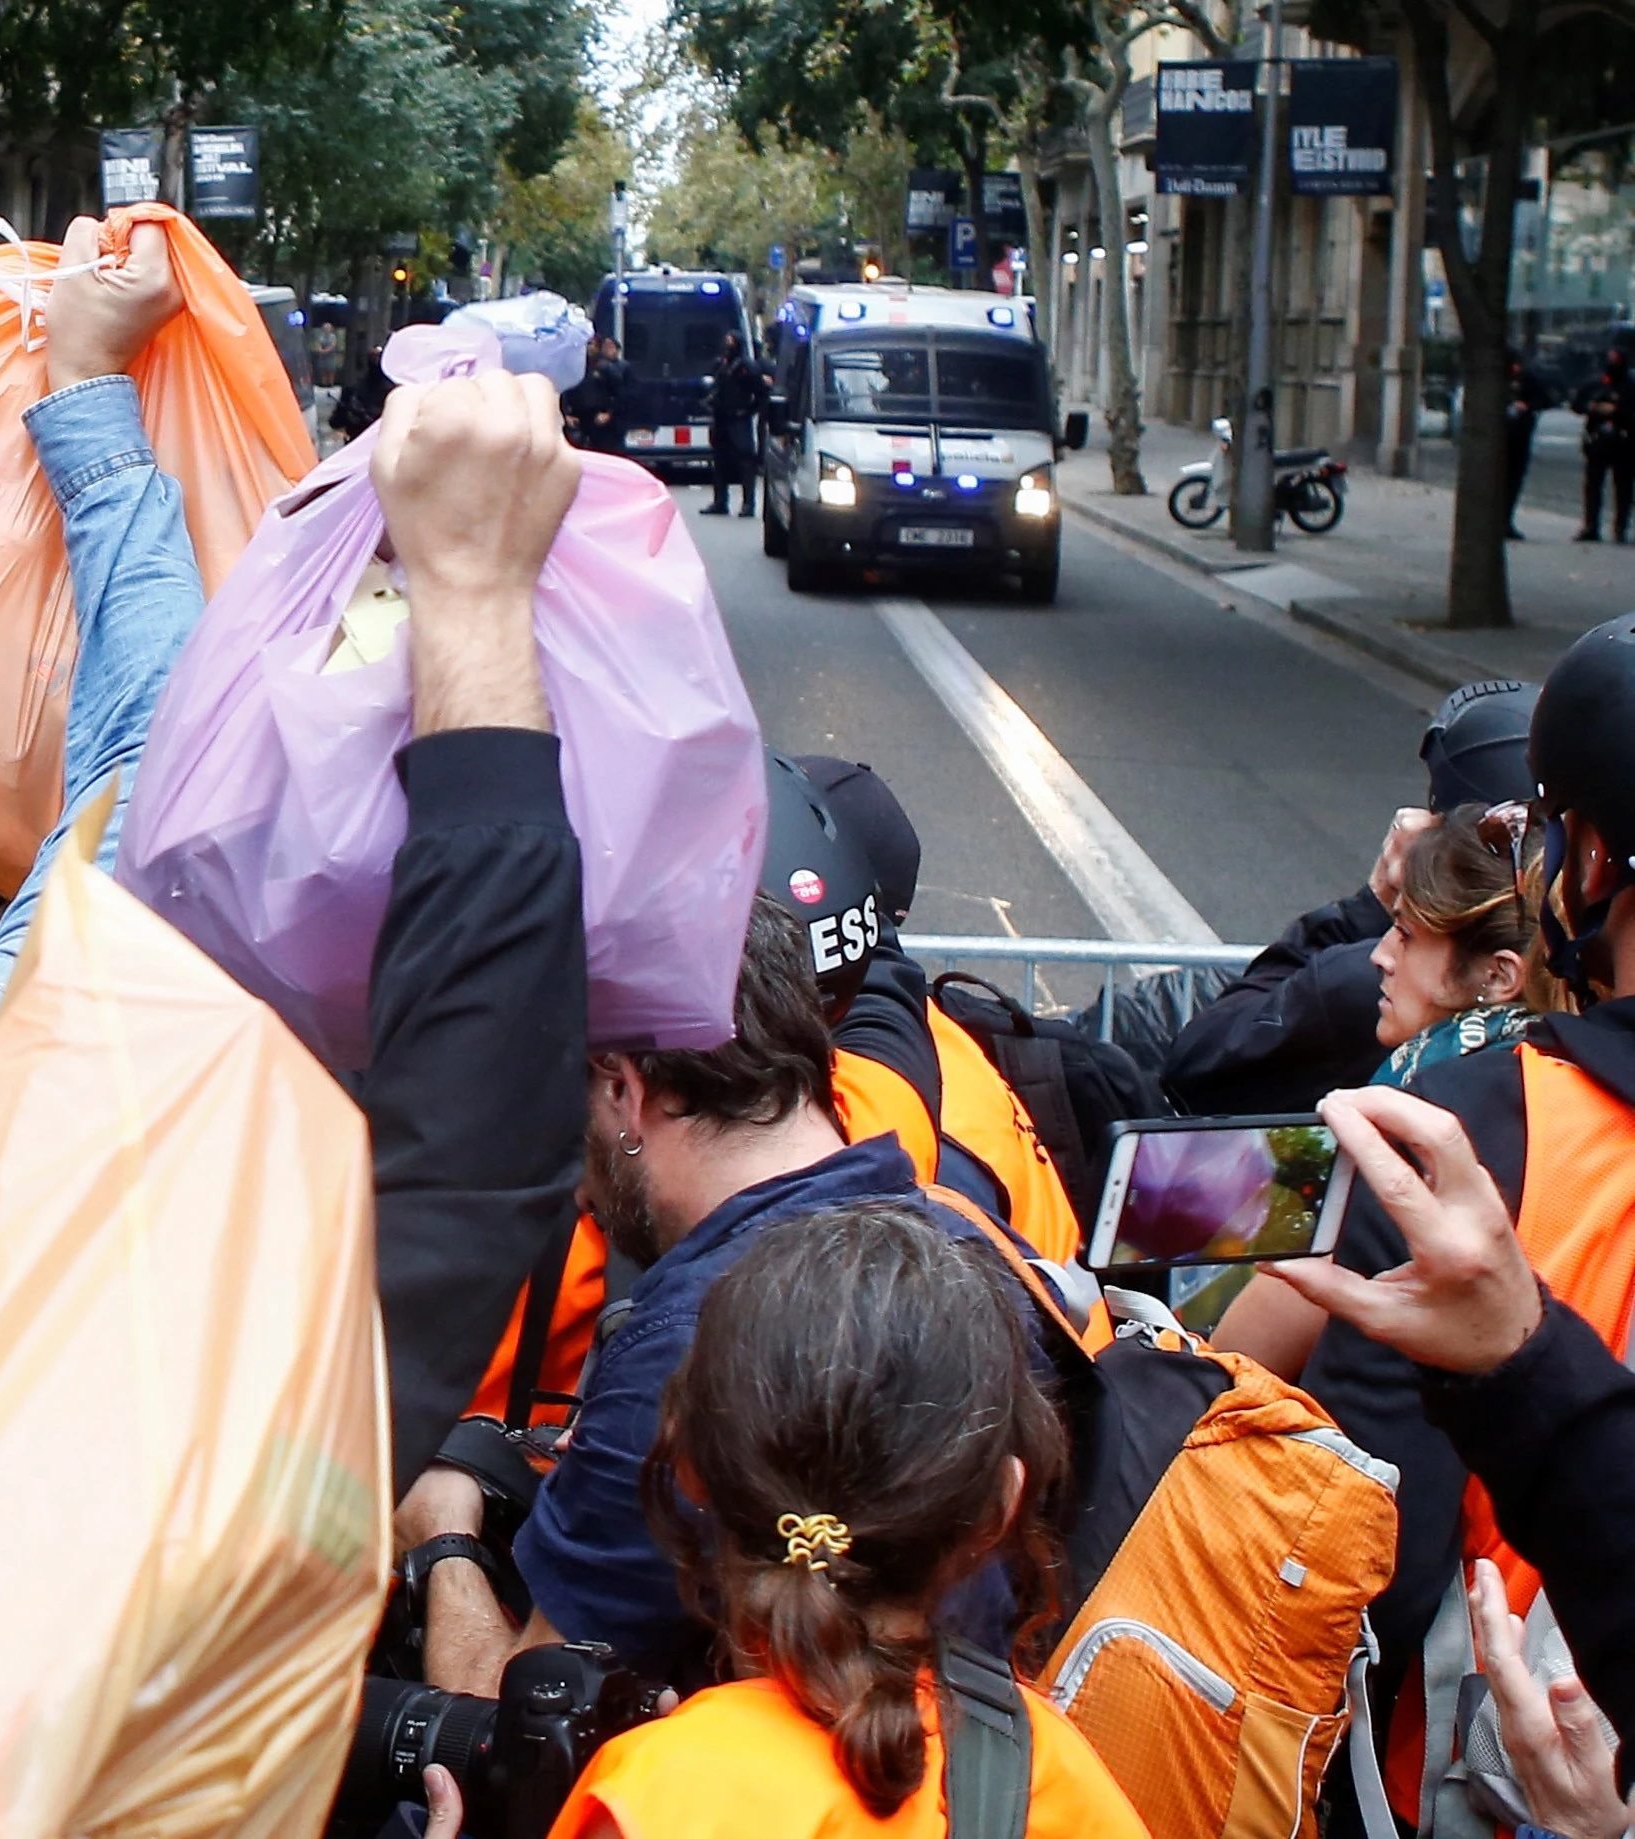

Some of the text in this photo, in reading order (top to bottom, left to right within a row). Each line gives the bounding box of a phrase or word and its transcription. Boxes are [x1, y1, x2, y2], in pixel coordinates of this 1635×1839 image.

[194, 161, 254, 175] TIVAL
[956, 222, 977, 251] P
[809, 894, 879, 974] ESS
